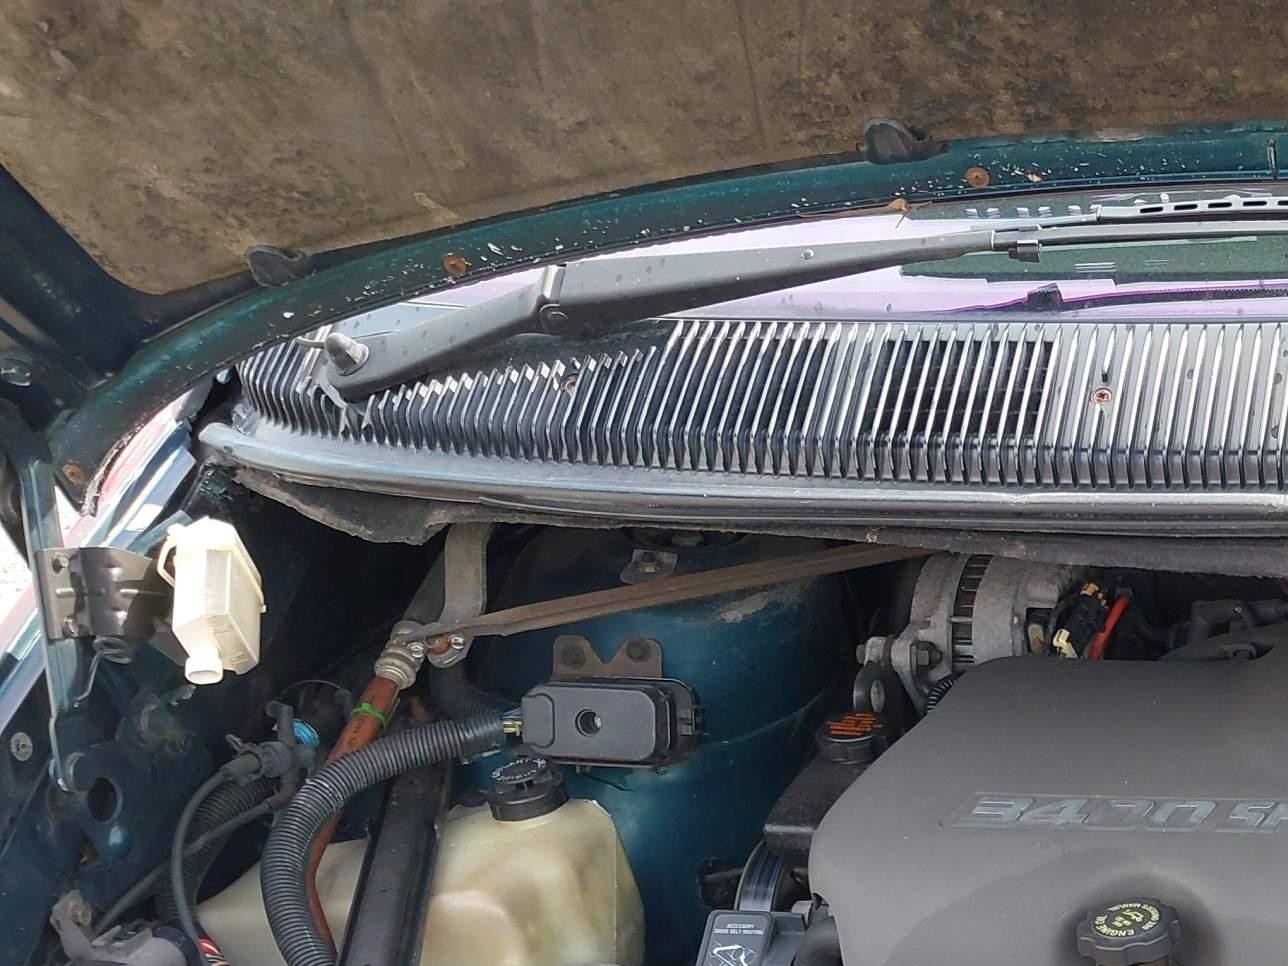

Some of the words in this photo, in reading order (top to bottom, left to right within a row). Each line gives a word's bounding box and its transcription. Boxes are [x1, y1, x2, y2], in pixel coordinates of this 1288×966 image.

[956, 797, 1217, 832] 3400
[1106, 902, 1142, 912] MANUAL
[1095, 923, 1136, 937] ENGINE
